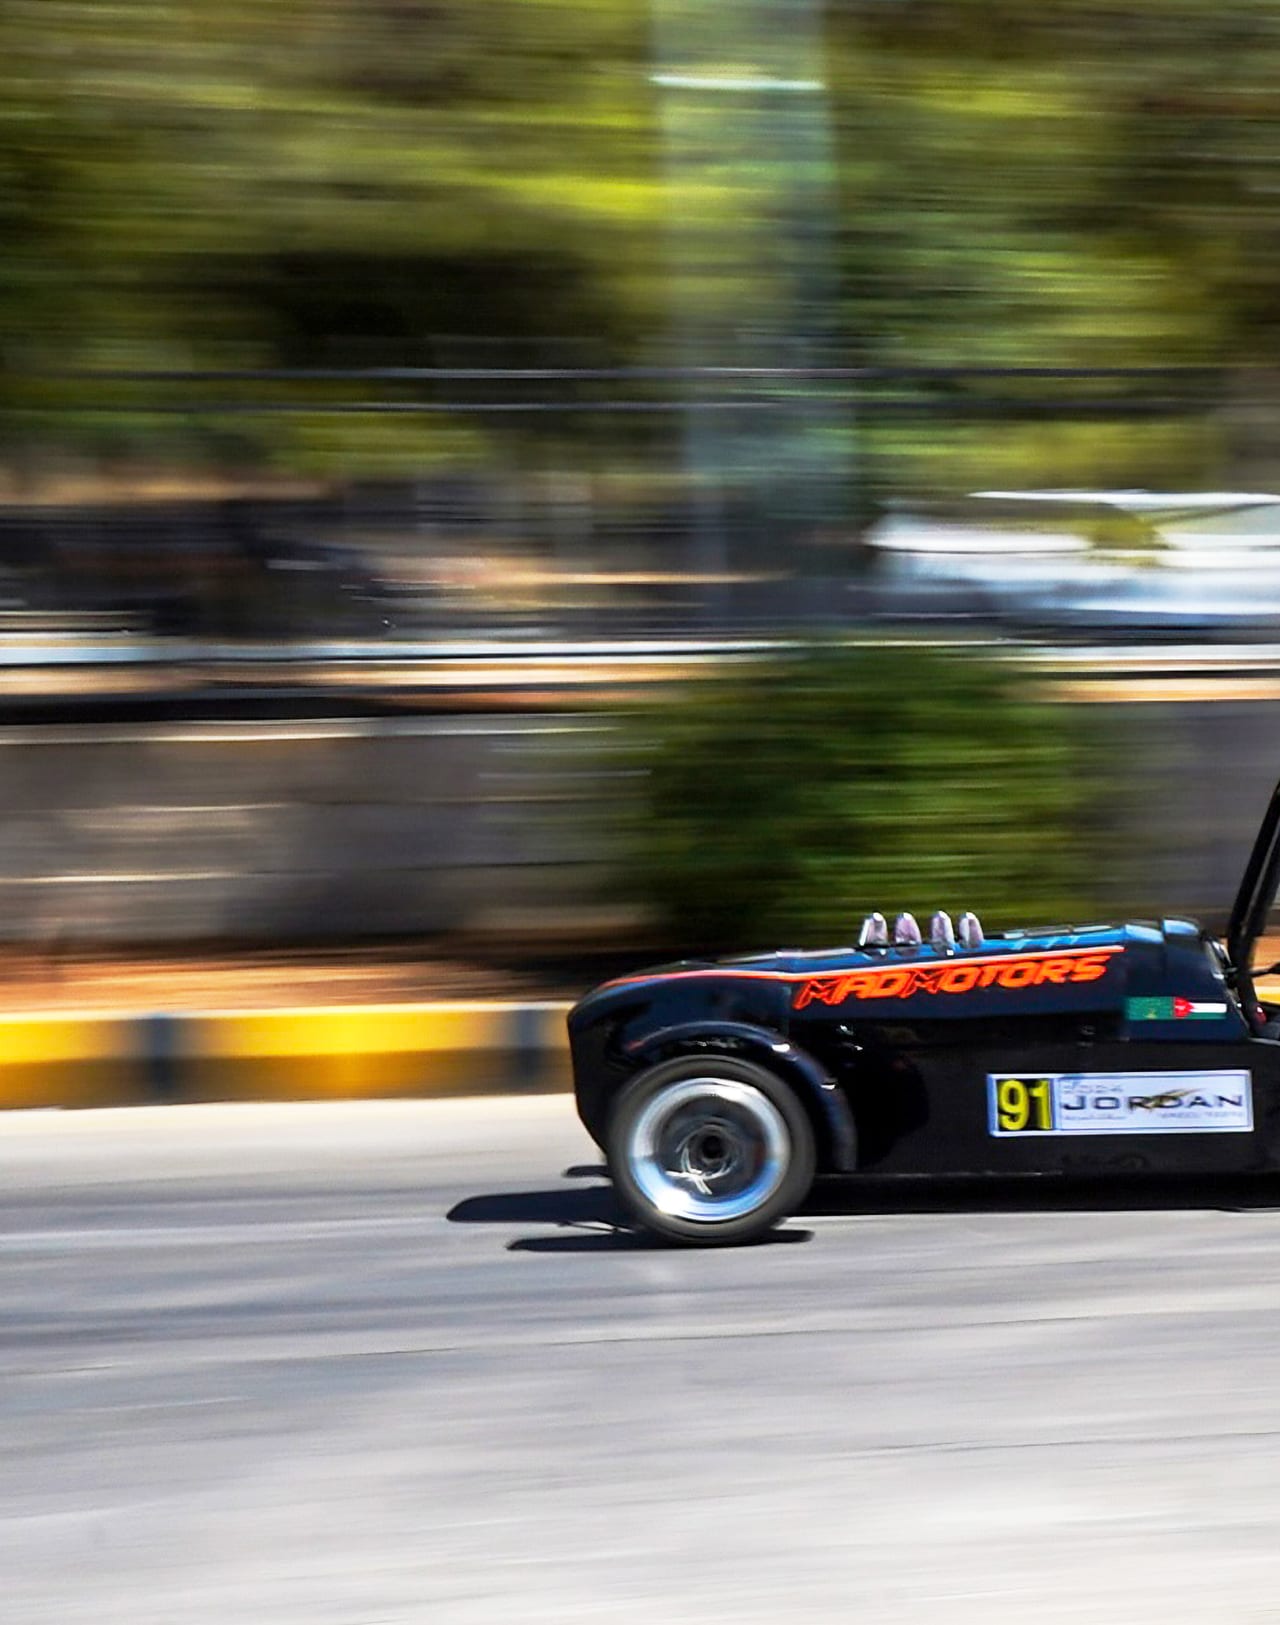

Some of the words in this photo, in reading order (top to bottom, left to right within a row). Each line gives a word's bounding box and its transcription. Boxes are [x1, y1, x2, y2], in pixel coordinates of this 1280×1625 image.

[792, 955, 1110, 1010] MADMOTORS
[1000, 1079, 1052, 1130] 91
[1063, 1095, 1243, 1111] JORDAN
